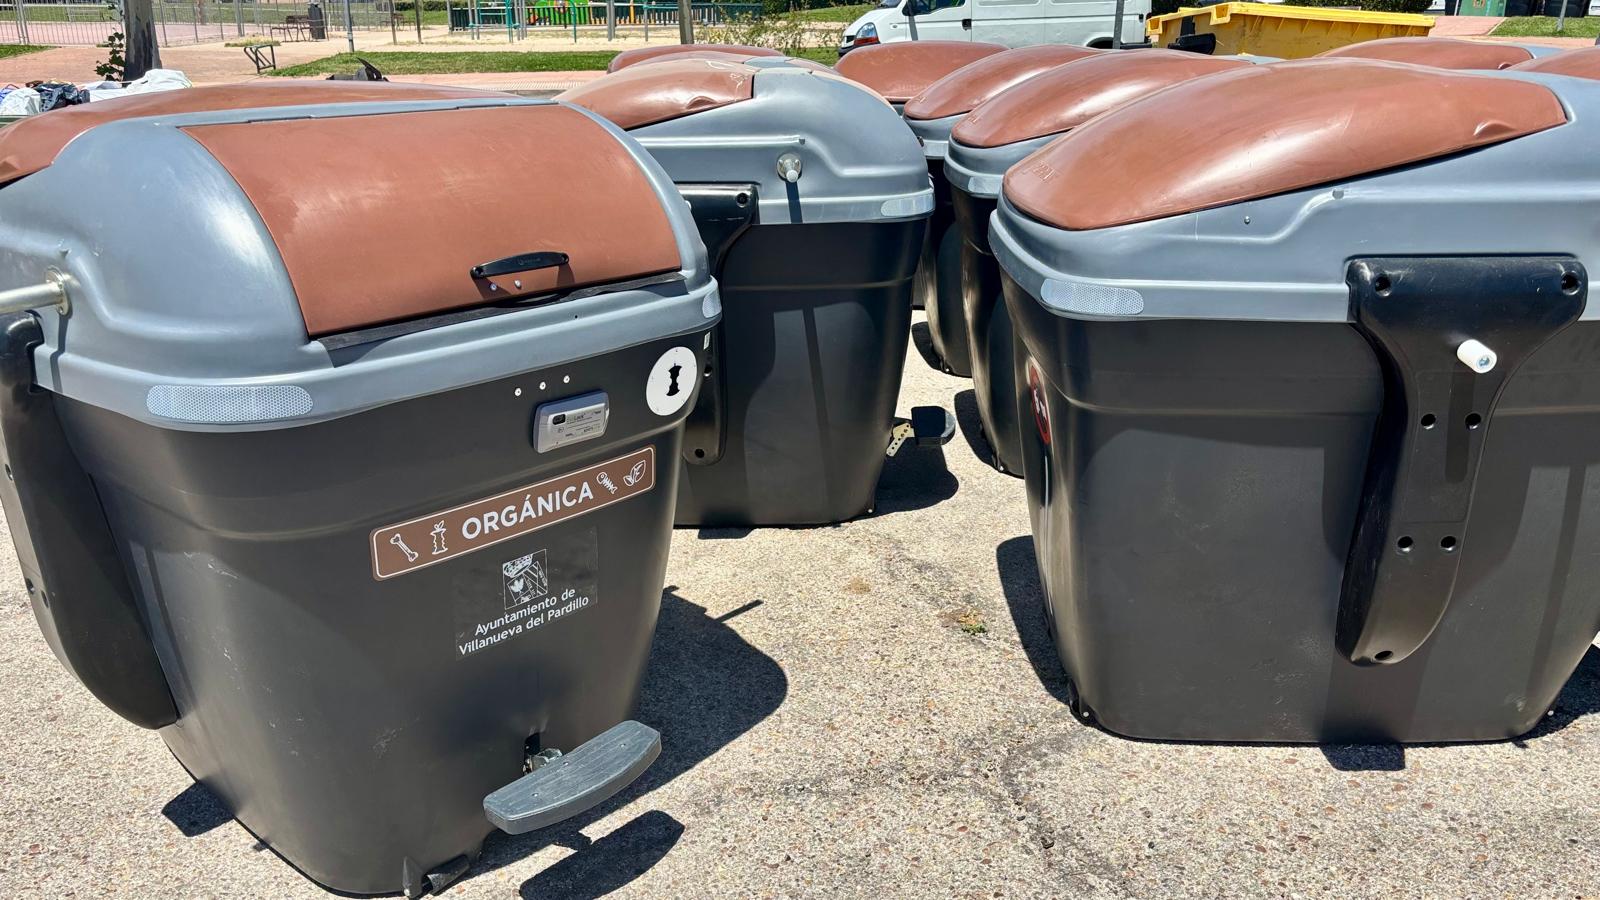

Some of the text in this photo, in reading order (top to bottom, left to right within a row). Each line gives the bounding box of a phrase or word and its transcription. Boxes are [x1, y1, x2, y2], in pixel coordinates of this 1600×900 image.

[461, 481, 594, 539] ORGÁNICA
[458, 595, 589, 655] Villanueva del Pardillo
[474, 596, 557, 636] Ayuntamiento
[561, 588, 576, 601] de
